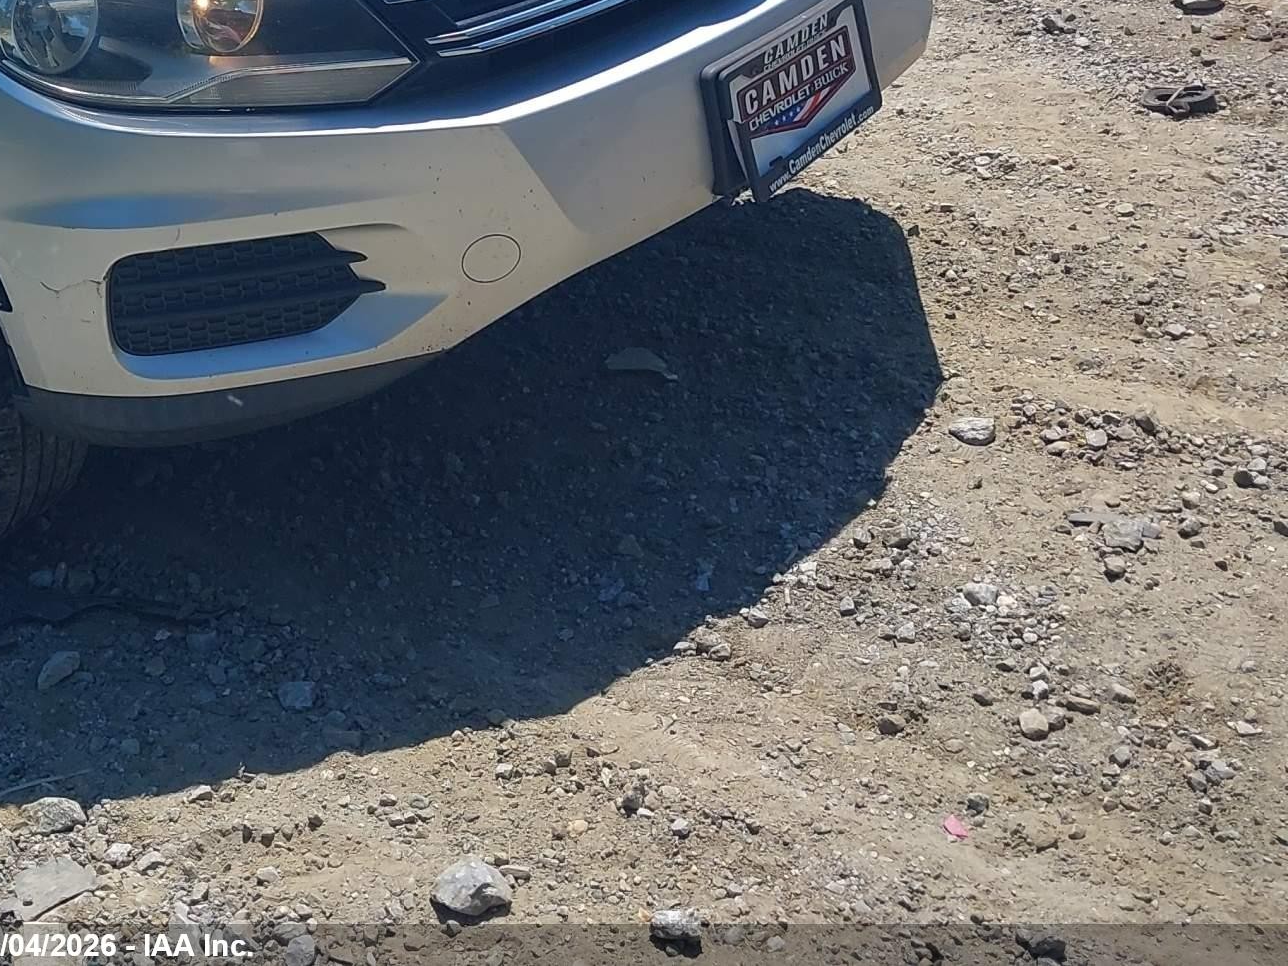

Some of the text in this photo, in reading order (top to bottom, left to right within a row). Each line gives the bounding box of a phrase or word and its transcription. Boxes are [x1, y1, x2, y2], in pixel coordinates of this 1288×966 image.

[764, 13, 828, 64] CAMDEN
[744, 34, 848, 115] CAMDEN
[749, 60, 849, 131] CHEVROLET BUICK
